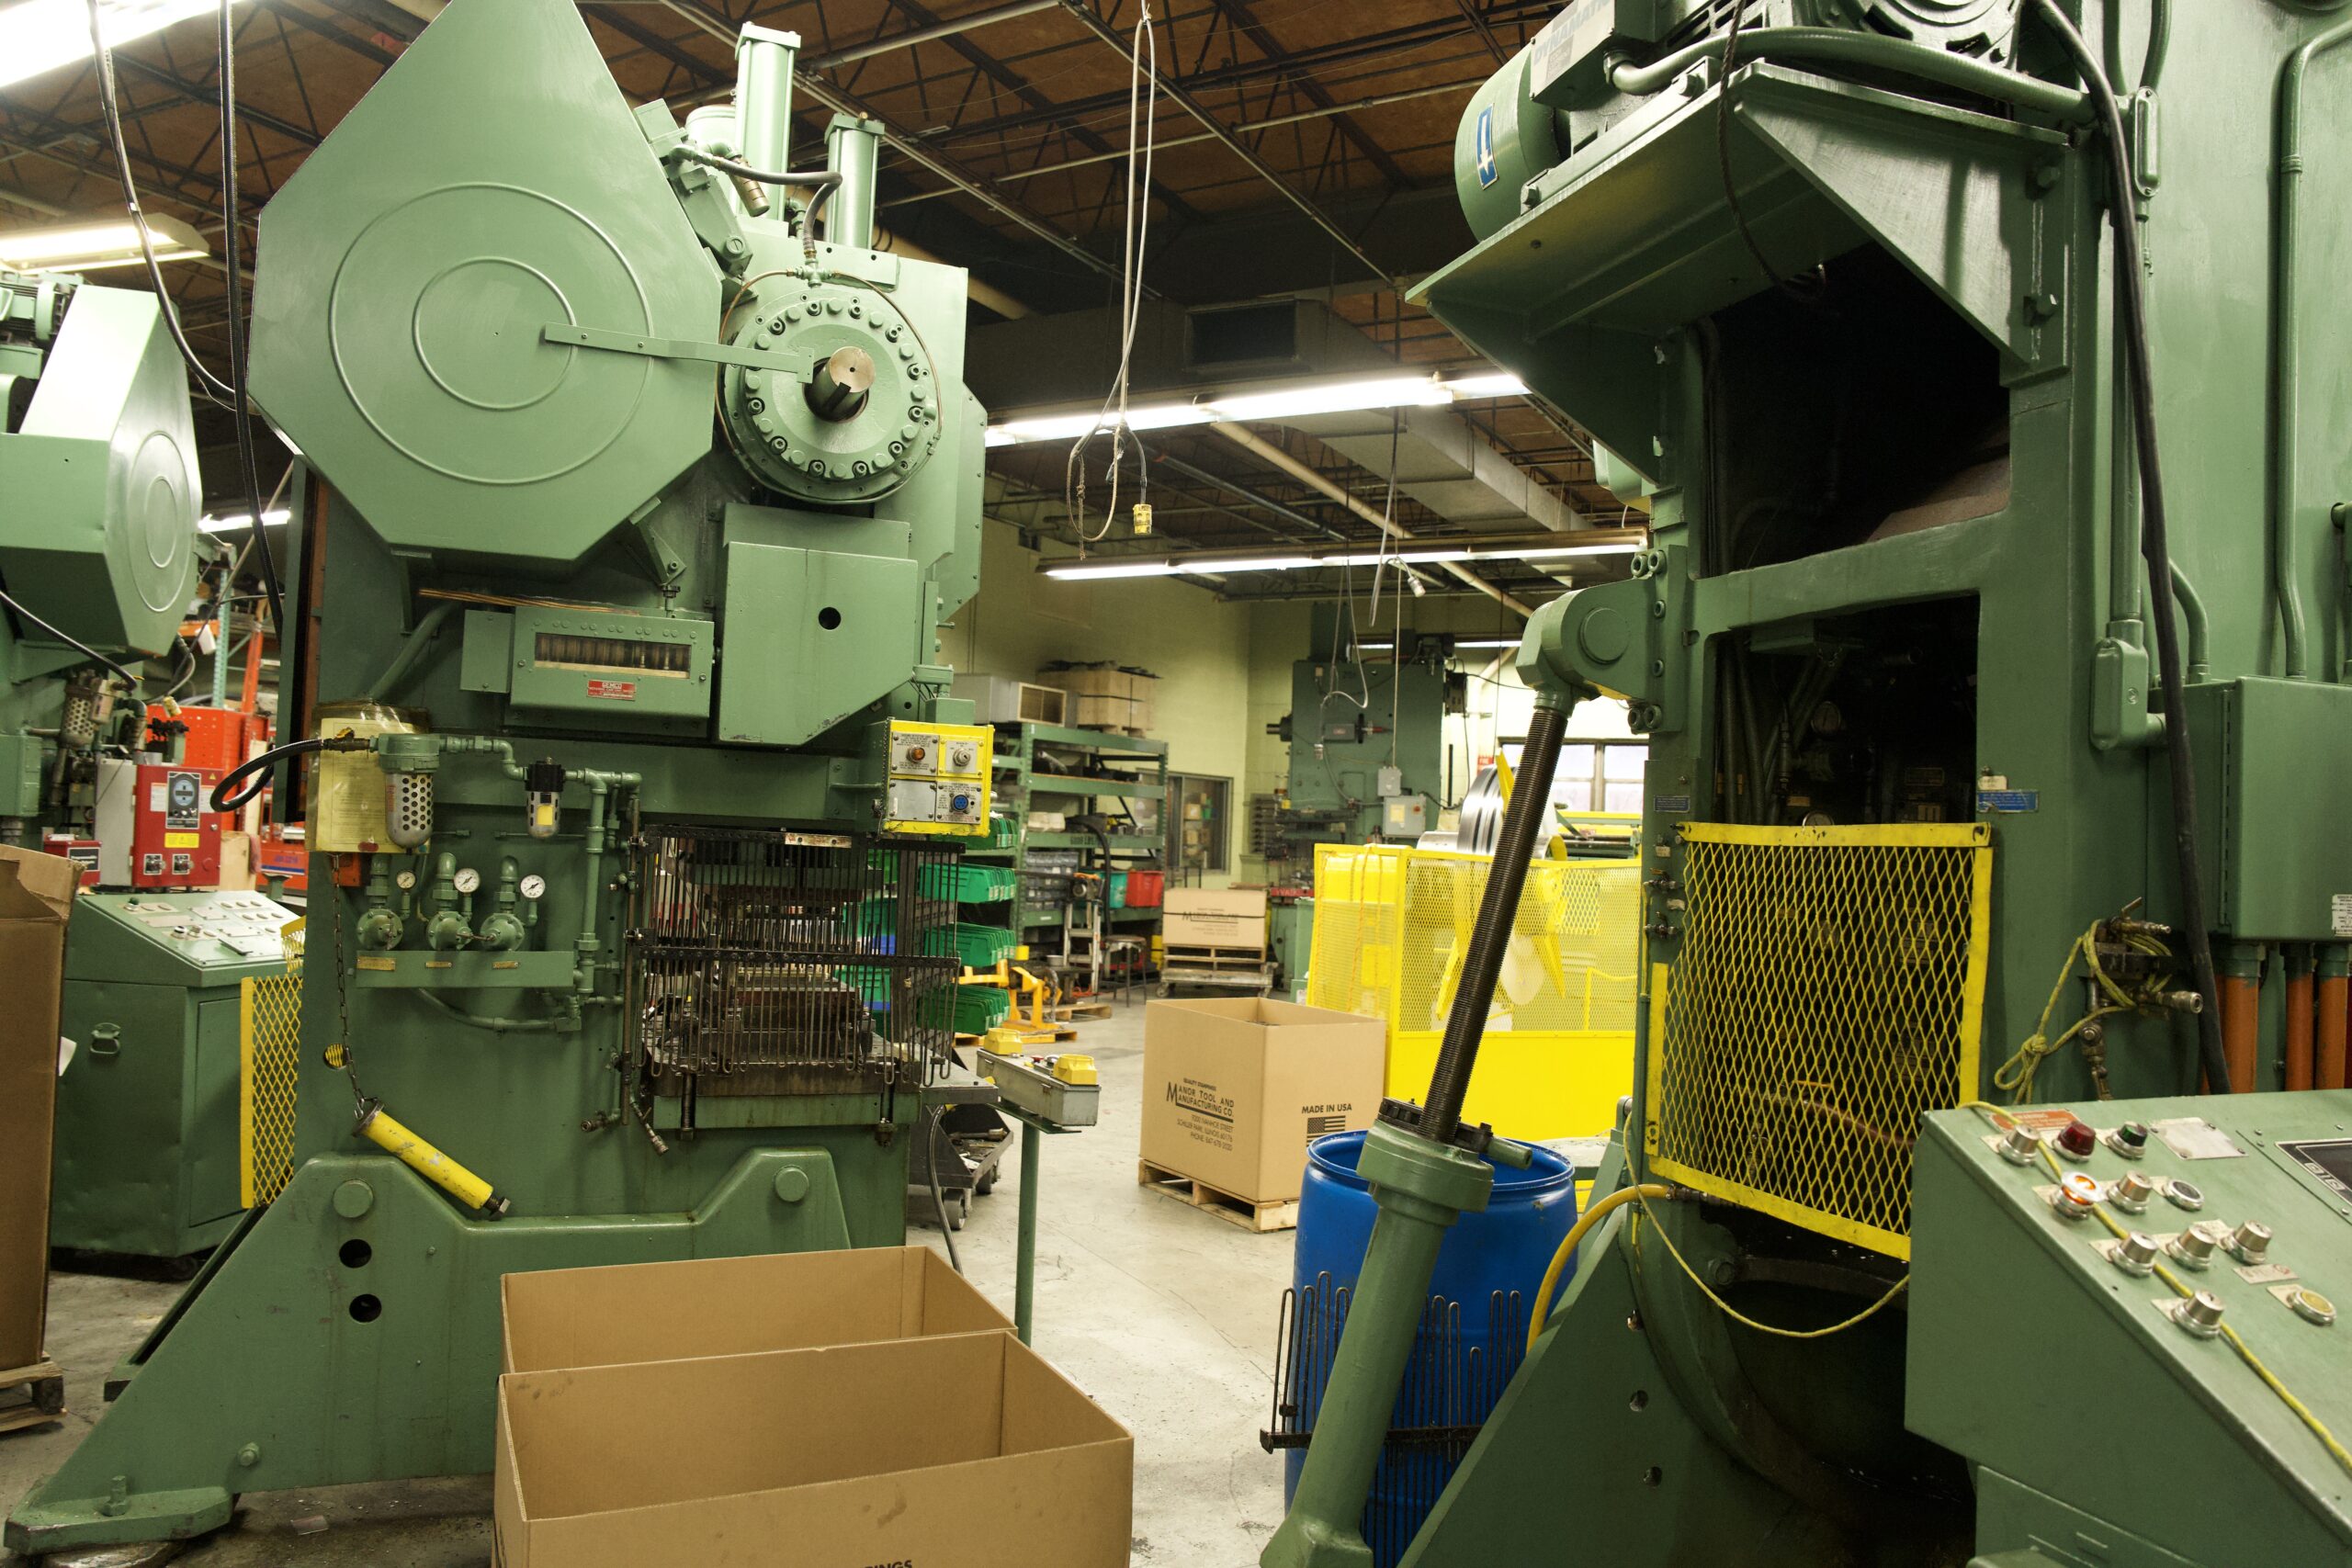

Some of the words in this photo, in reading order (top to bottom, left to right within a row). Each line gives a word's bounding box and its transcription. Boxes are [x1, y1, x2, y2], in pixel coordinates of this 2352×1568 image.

[1199, 1089, 1216, 1102] TOOL
[1220, 1097, 1235, 1108] AND
[1301, 1105, 1324, 1114] MADE
[1326, 1104, 1335, 1112] IN
[1337, 1103, 1352, 1111] USA
